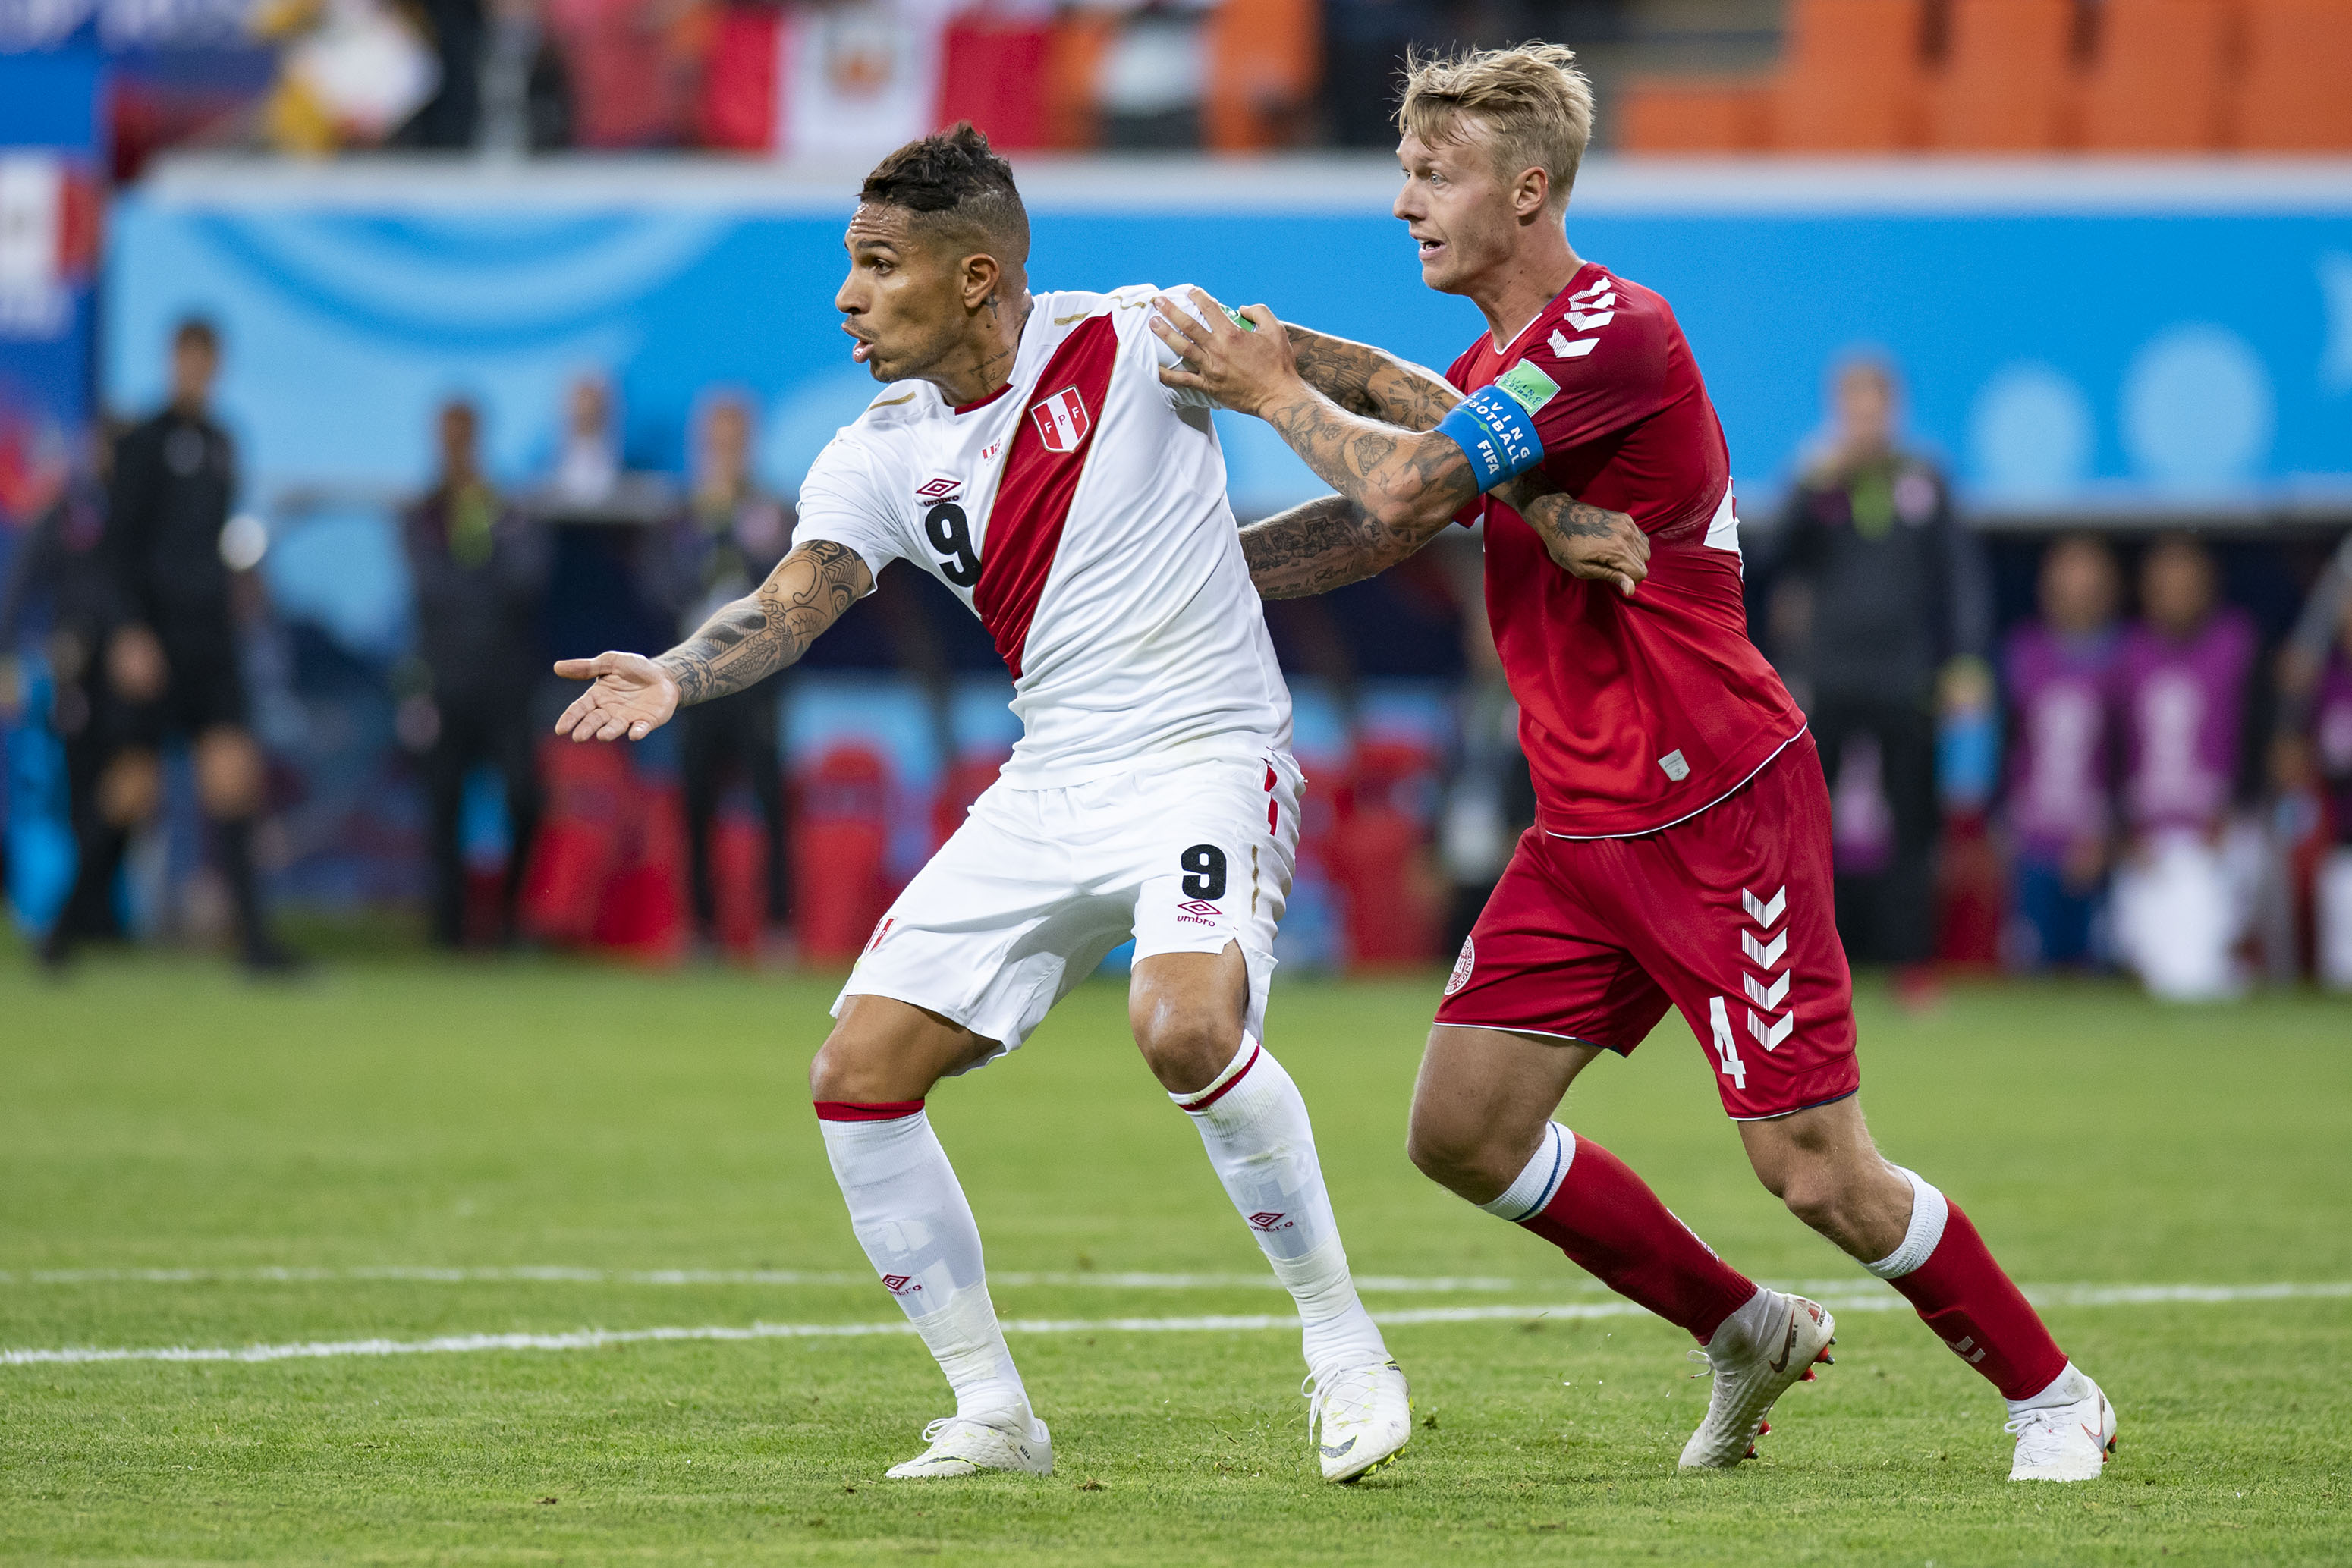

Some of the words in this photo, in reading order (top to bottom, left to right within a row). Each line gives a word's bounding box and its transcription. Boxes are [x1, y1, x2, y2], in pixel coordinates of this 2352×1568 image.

[1470, 391, 1530, 459] LIVING
[1477, 439, 1500, 475] FIFA
[923, 495, 960, 507] umbro
[925, 503, 982, 588] 9
[1181, 844, 1227, 901] 9
[1177, 916, 1215, 927] umbro
[1709, 995, 1747, 1089] 4
